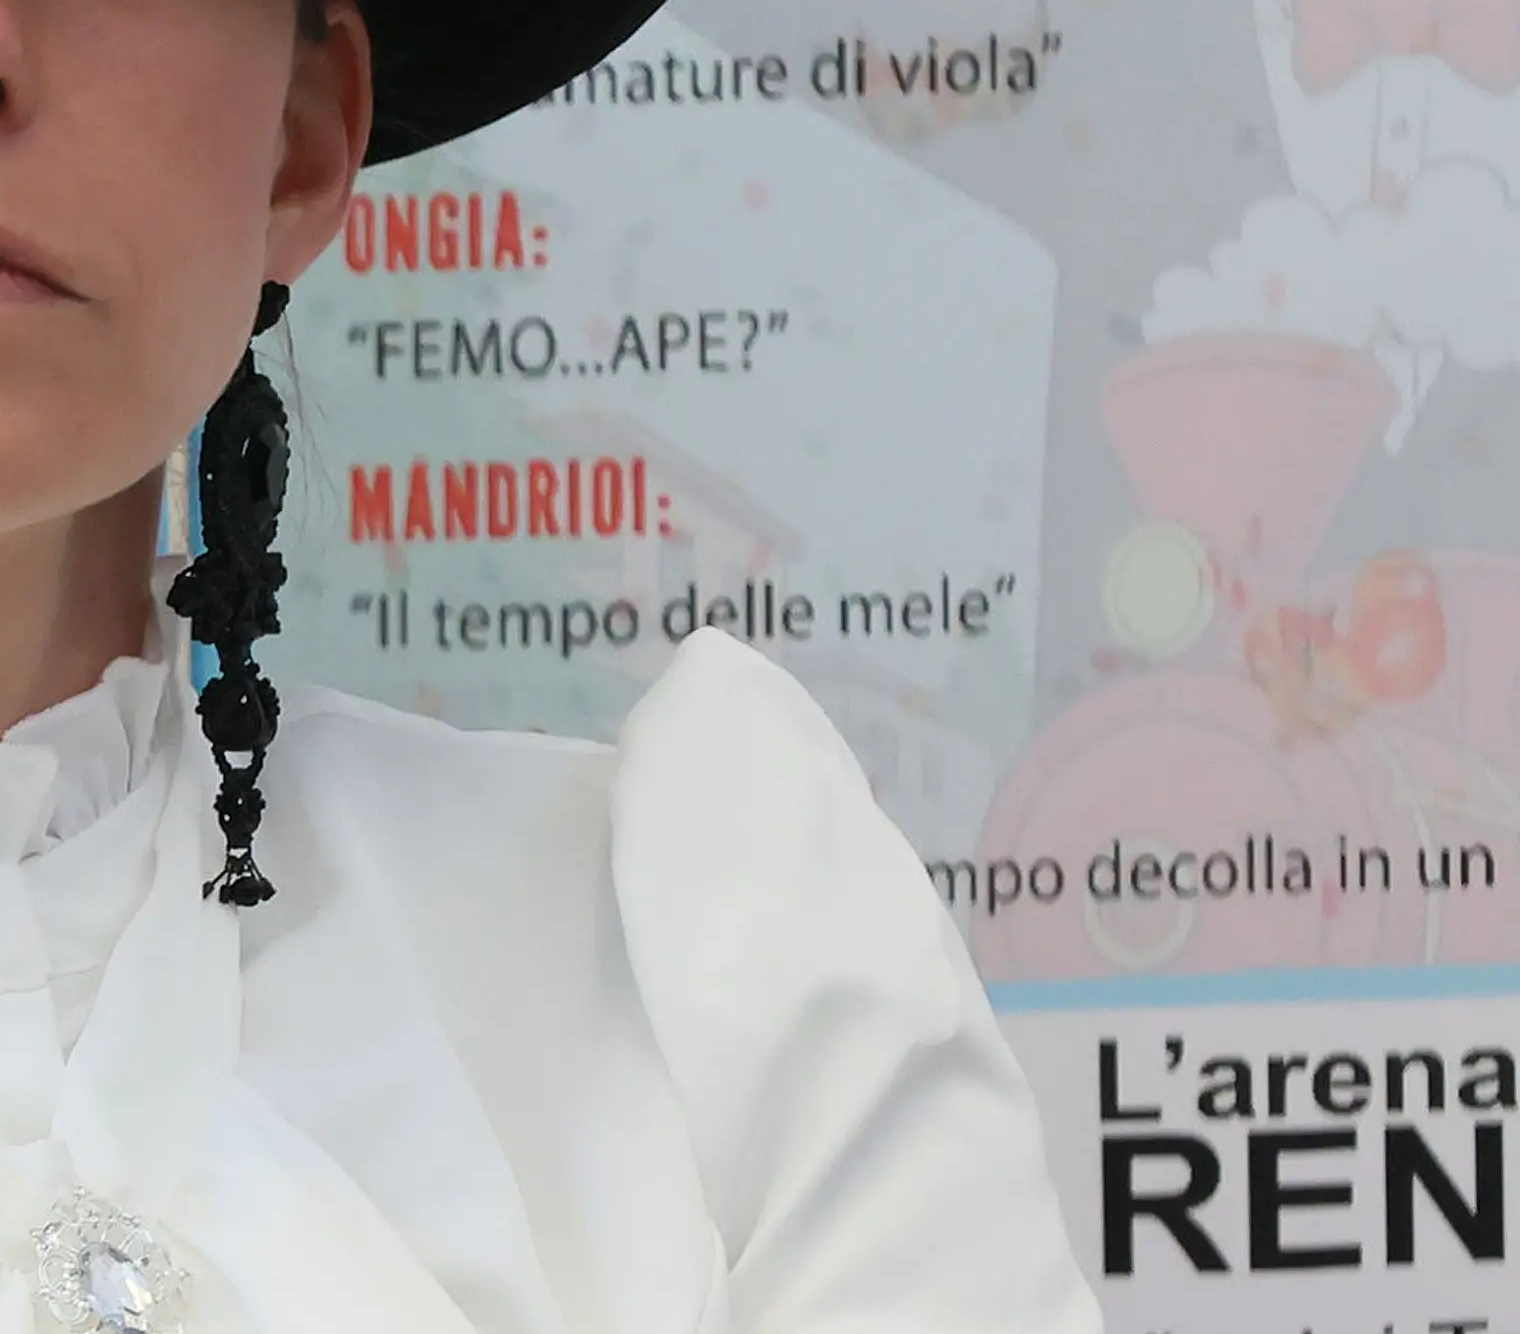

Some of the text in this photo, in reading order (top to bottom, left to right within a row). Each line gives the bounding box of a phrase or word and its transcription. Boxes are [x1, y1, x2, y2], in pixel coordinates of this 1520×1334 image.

[811, 38, 866, 98] di
[344, 191, 549, 274] ONGIA:
[348, 457, 675, 543] MANDRIOI:
[434, 596, 640, 659] tempo
[661, 580, 815, 644] delle
[1087, 833, 1314, 904] decolla
[1339, 834, 1391, 895] in
[1418, 839, 1497, 894] un
[1097, 1034, 1518, 1123] L’arena
[1102, 1120, 1506, 1278] REN
